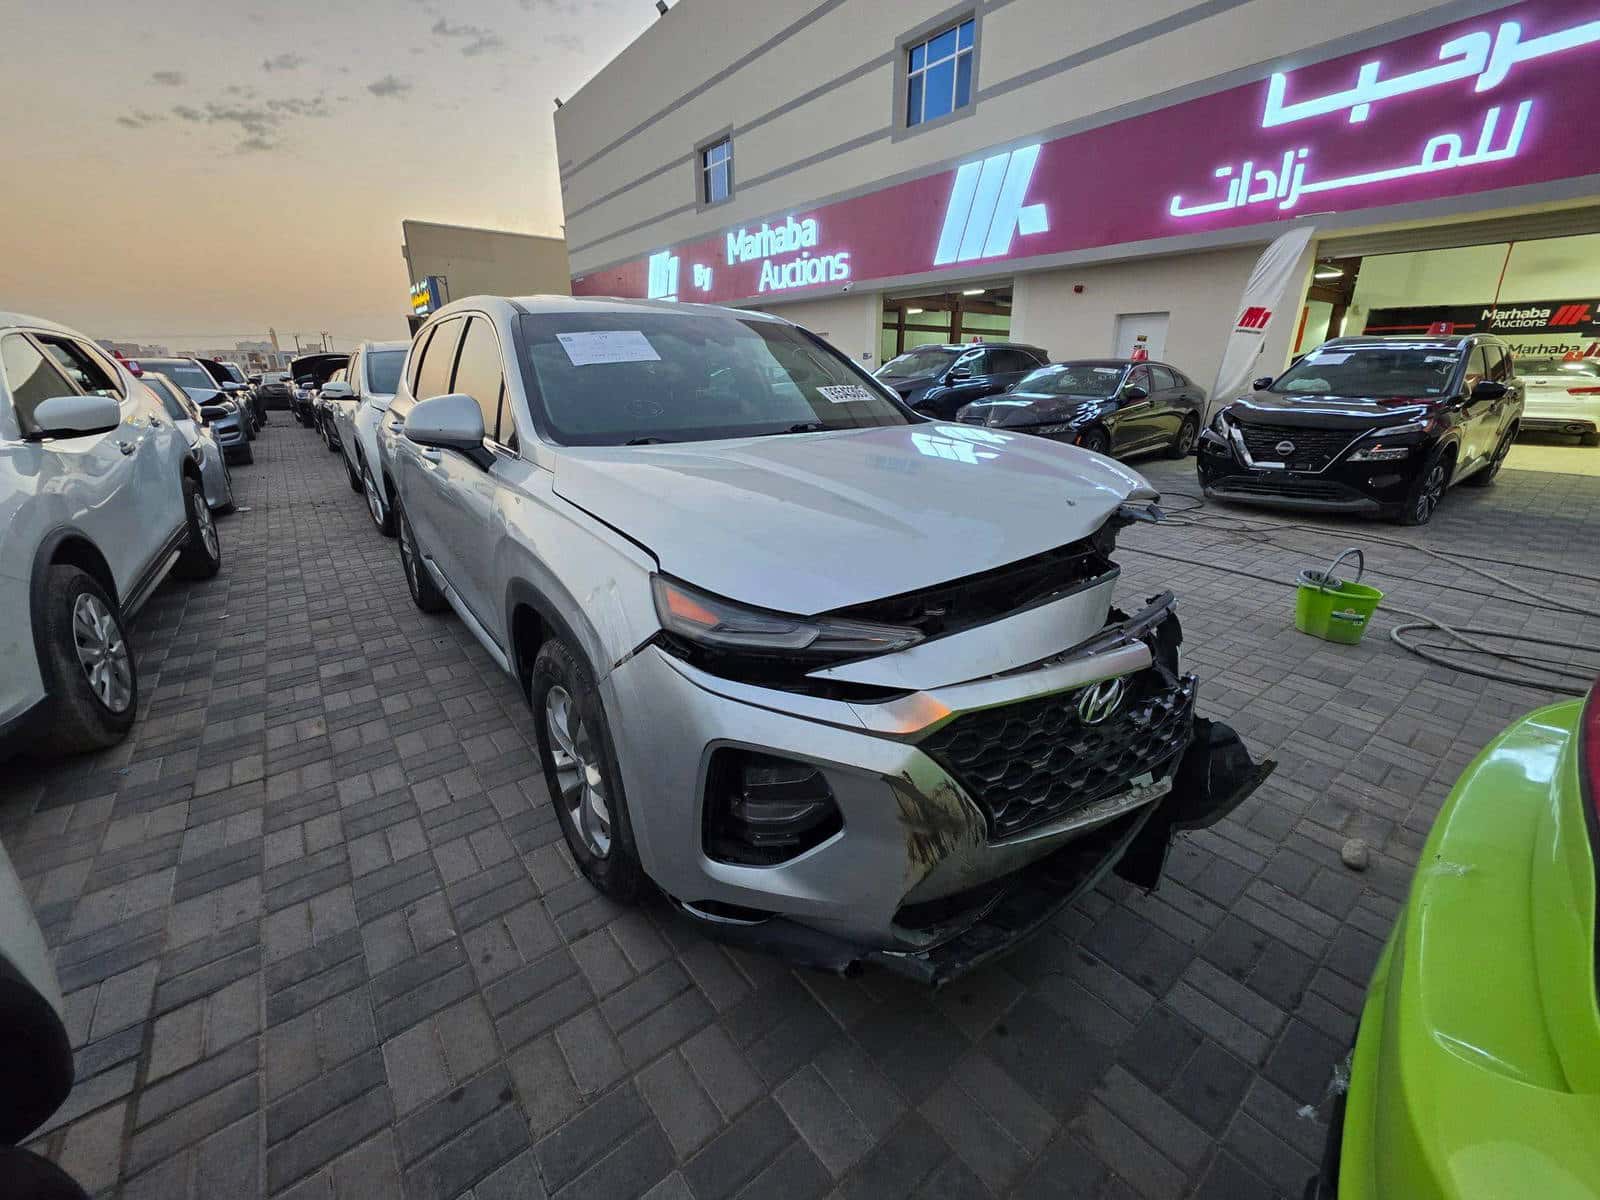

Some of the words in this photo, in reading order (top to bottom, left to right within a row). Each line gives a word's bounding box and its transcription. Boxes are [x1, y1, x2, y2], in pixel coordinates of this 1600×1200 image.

[1262, 21, 1600, 128] رحبا
[1169, 100, 1533, 217] للمزادات
[727, 215, 817, 266] Marhaba
[758, 251, 849, 292] Auctions
[1481, 308, 1552, 321] Marhaba
[1491, 318, 1547, 329] Auctions
[1509, 343, 1581, 355] Marhaba
